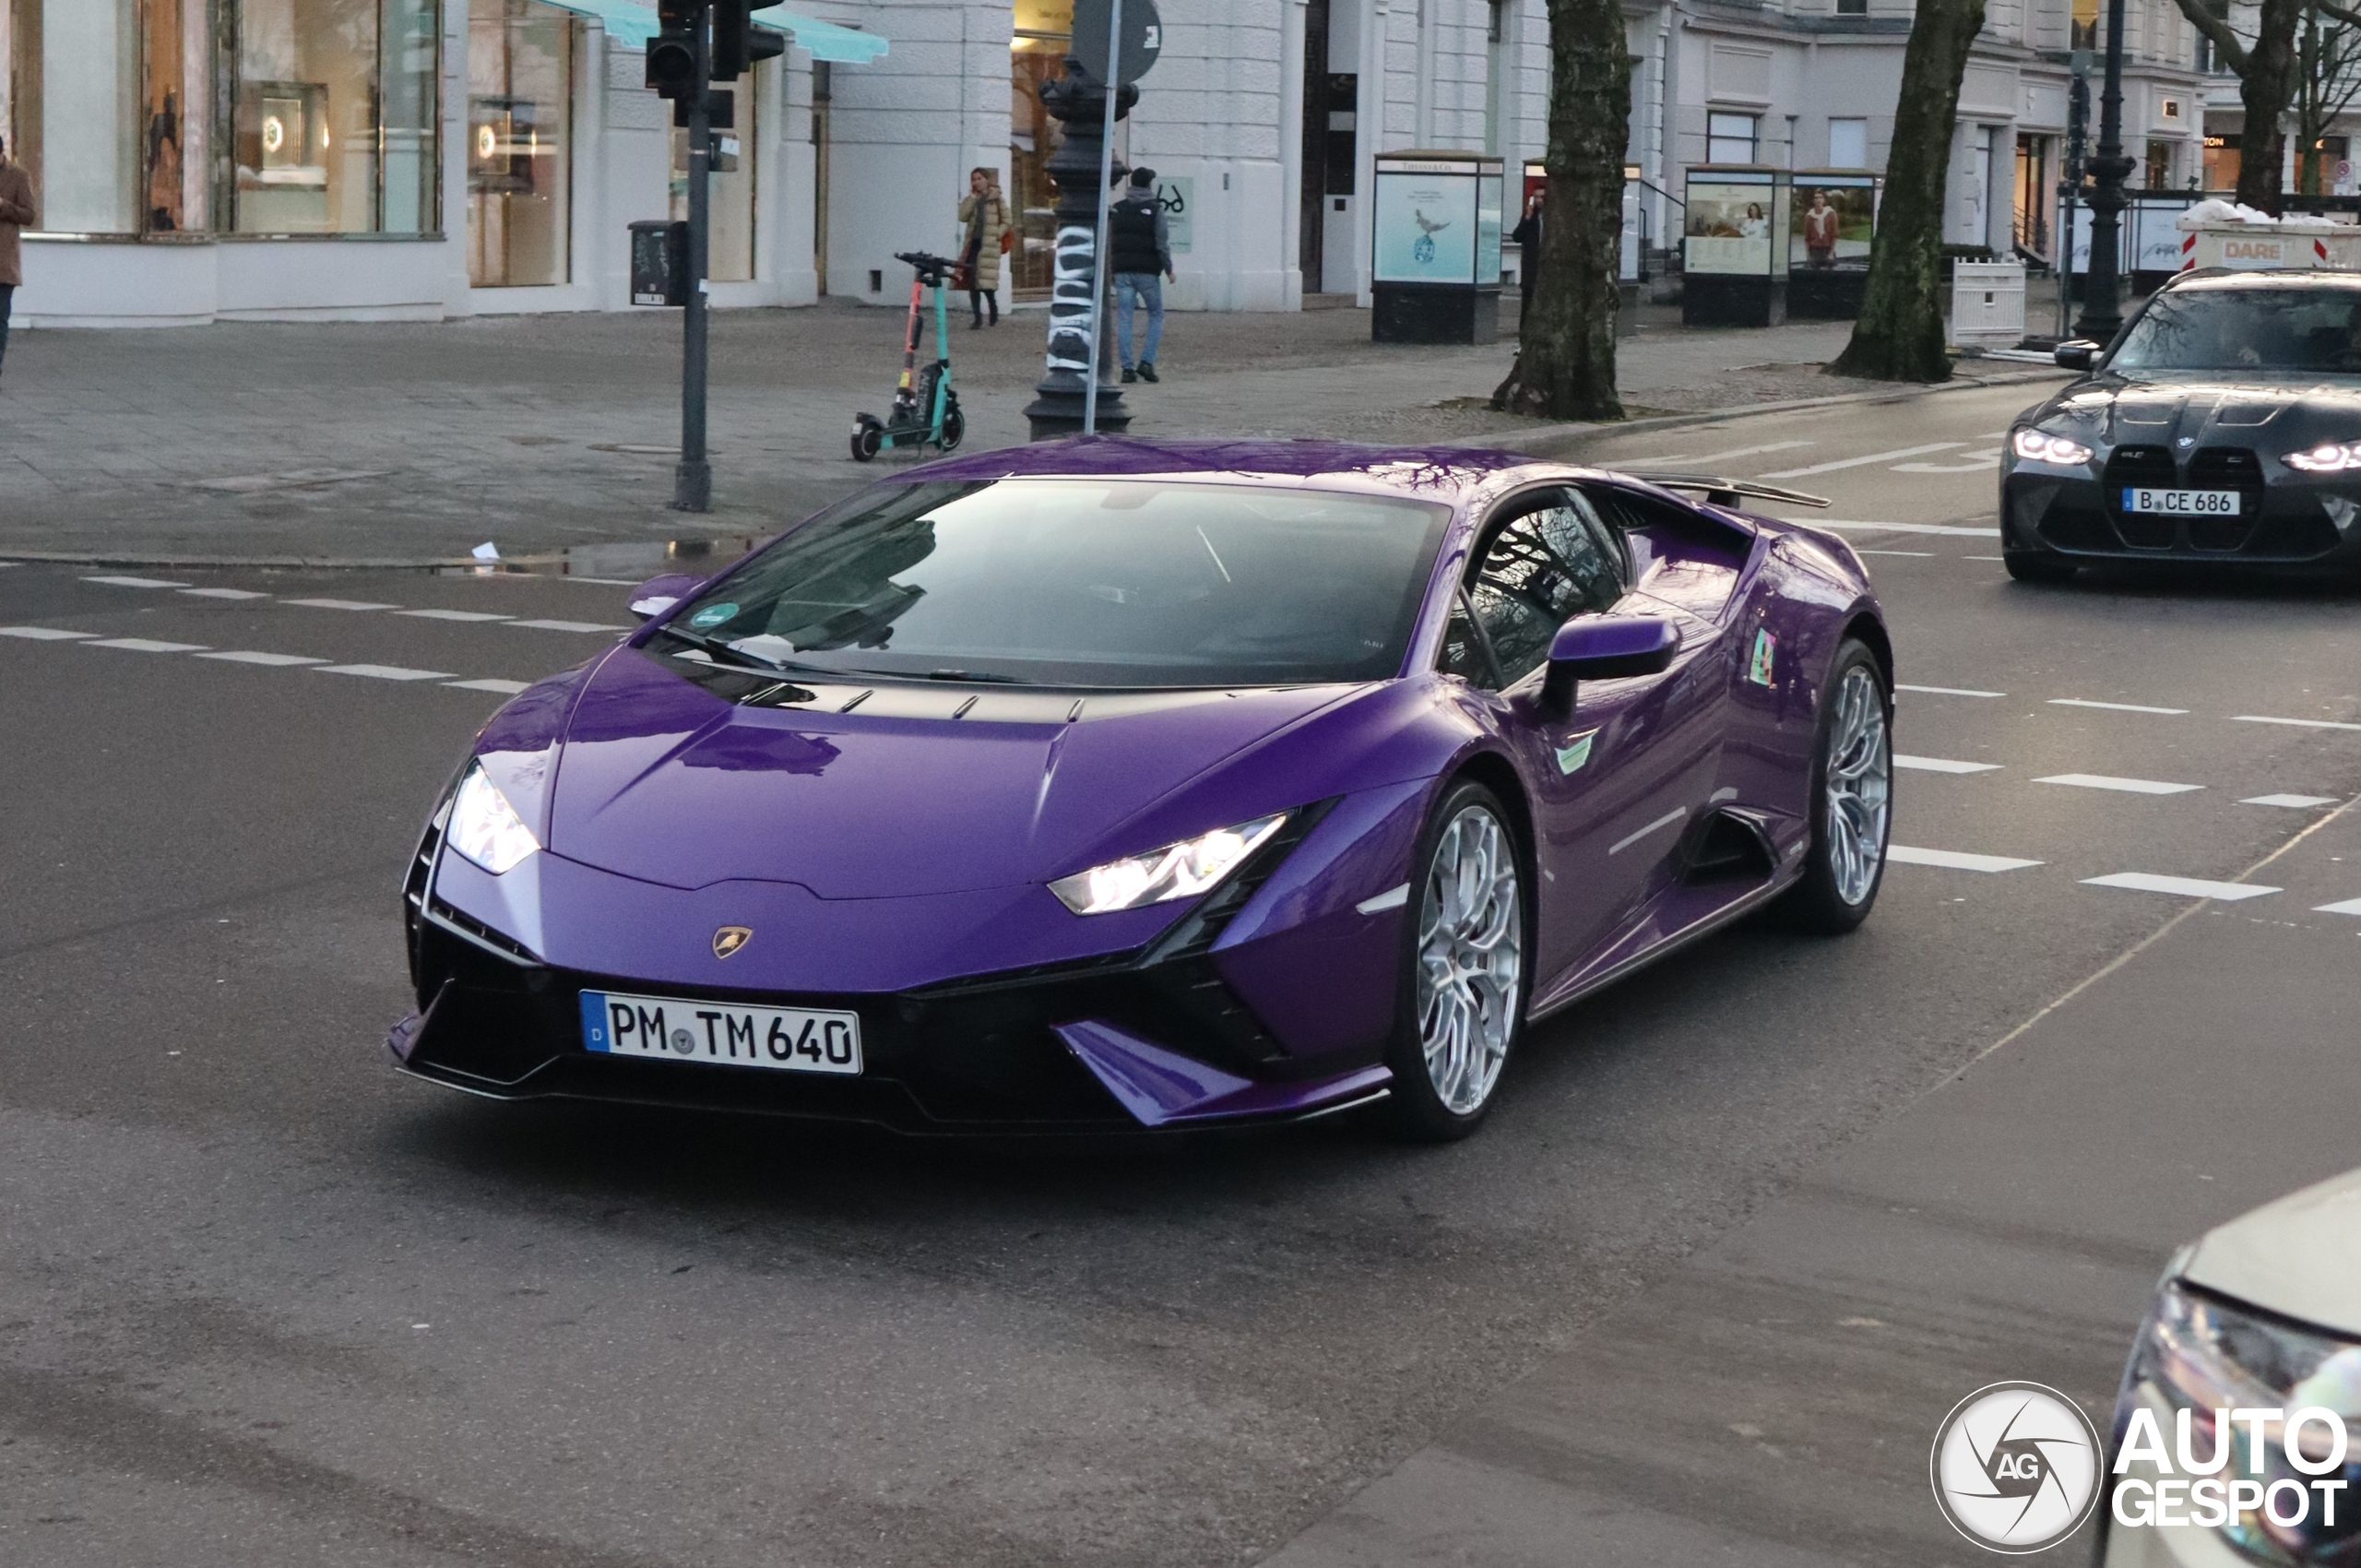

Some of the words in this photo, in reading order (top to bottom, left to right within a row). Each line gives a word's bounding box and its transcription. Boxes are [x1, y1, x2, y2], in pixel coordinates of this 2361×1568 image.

[2225, 242, 2282, 259] DARE
[2141, 492, 2153, 509] B
[2165, 493, 2189, 511] CE
[2195, 493, 2231, 512] 686
[591, 1028, 603, 1041] D
[609, 1003, 668, 1051] PM
[695, 1011, 756, 1059] TM
[766, 1016, 852, 1064] 640
